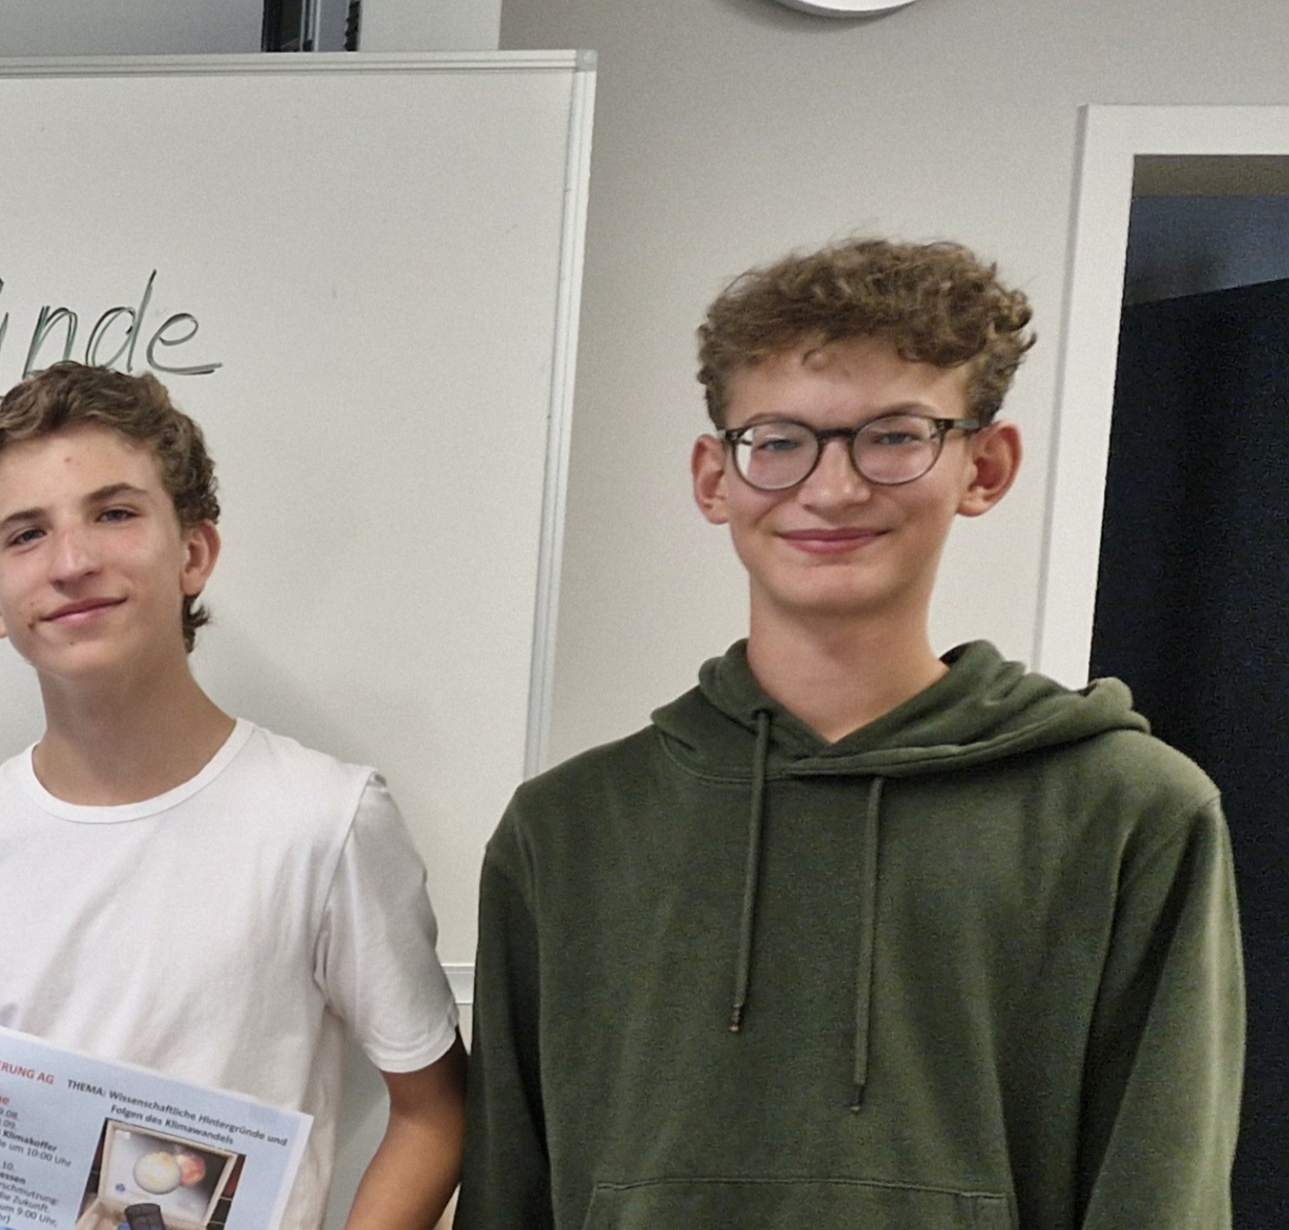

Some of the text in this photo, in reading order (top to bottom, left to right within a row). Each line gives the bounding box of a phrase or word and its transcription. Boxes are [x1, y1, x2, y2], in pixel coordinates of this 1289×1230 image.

[36, 1071, 55, 1085] AG
[67, 1079, 288, 1148] THEMA: Wissenschaftliche Hintergründe und
[110, 1104, 234, 1145] Folgen des Klimawandels
[2, 1128, 58, 1153] Klimakoffer
[9, 1143, 24, 1153] um
[26, 1147, 53, 1162] 10:00
[54, 1155, 72, 1168] Uhr
[0, 1203, 15, 1213] um
[16, 1205, 38, 1220] 9:00
[12, 1194, 52, 1214] Zukunft.
